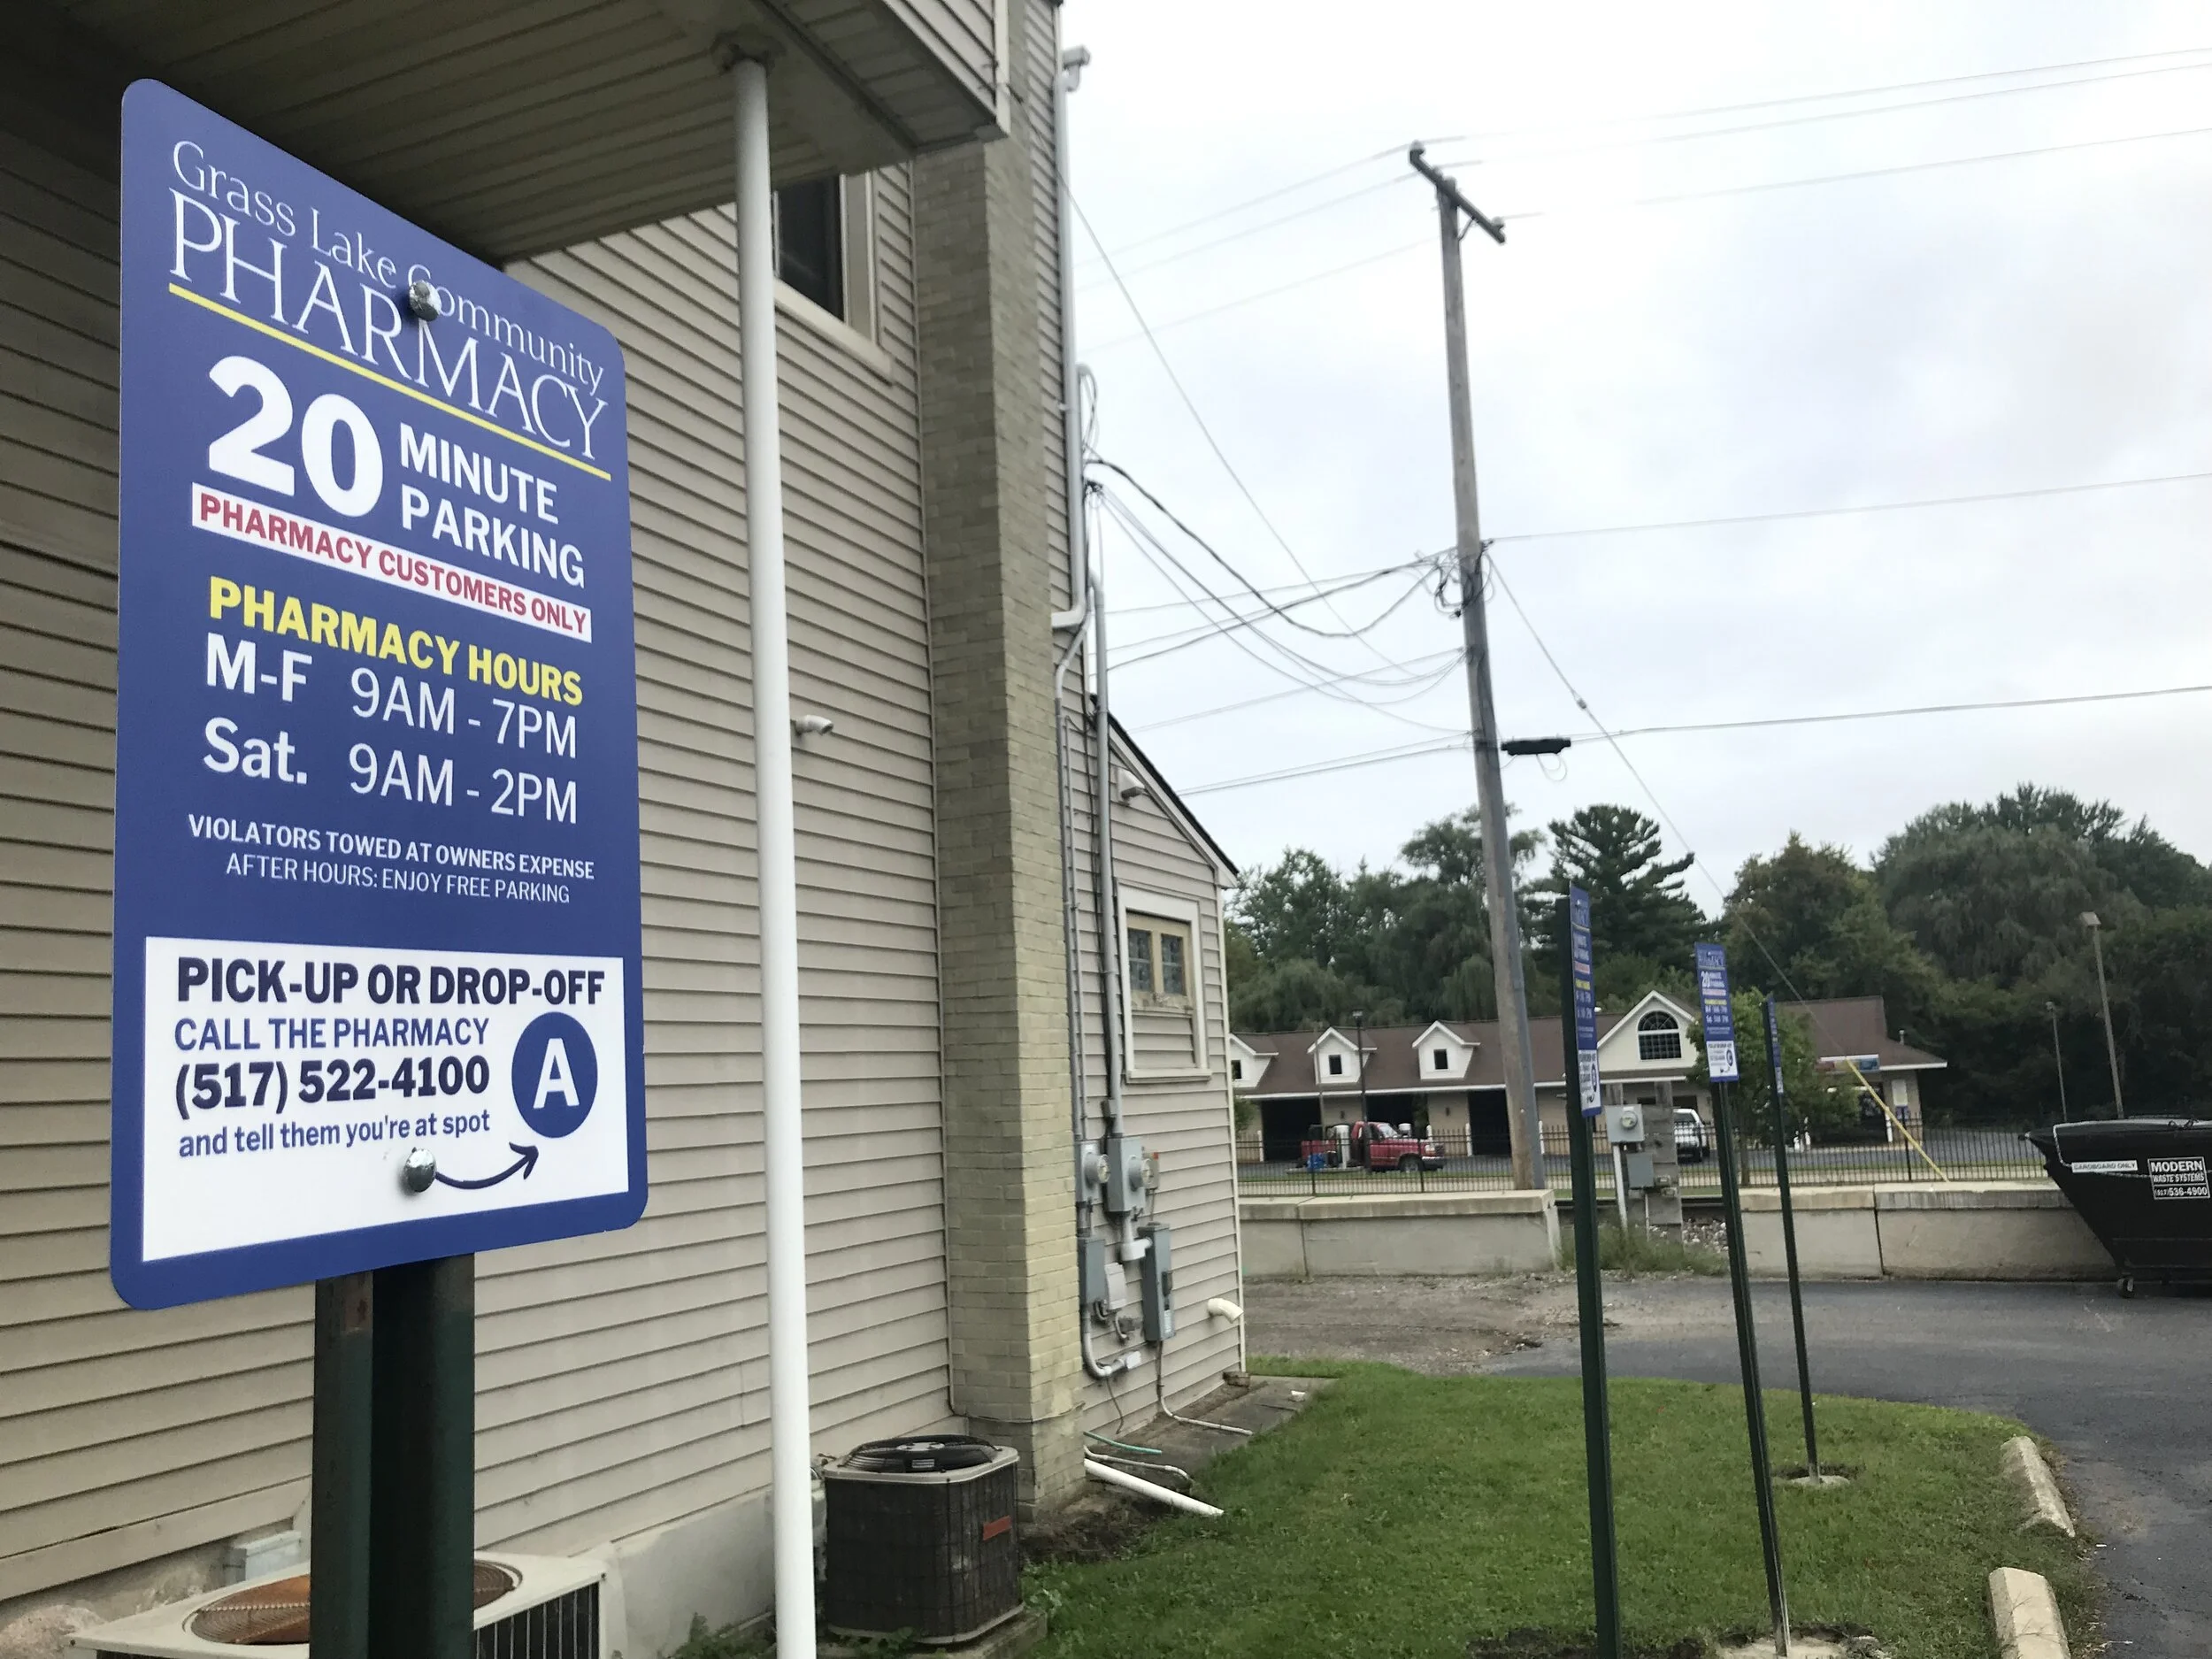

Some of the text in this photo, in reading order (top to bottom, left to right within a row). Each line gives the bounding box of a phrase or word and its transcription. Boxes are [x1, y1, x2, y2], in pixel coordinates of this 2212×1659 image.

[173, 141, 295, 236] Grass
[312, 208, 396, 288] Lake
[170, 188, 608, 460] PHARMACY
[209, 355, 383, 517] 20
[400, 422, 558, 524] MINUTE
[200, 493, 586, 634] PHARMACY CUSTOMERS ONLY
[402, 484, 584, 588] PARKING
[211, 576, 583, 705] PHARMACY HOURS
[206, 633, 312, 702] M-F
[350, 668, 454, 734] 9AM
[492, 698, 576, 758] 7PM
[204, 718, 307, 784] Sat.
[349, 743, 453, 806] 9AM
[490, 769, 577, 824] 2PM
[188, 814, 595, 879] VIOLATORS TOWED AT OWNERS EXPENSE
[227, 854, 569, 903] AFTER HOURS: ENJOY FREE PARKING
[178, 956, 604, 1005] PICK-UP OR DROP-OFF
[175, 1018, 488, 1051] CALL THE PHARMACY
[534, 1038, 579, 1109] A
[176, 1055, 489, 1119] (517) 522-4100
[179, 1110, 489, 1157] and tell them you're at spot
[2151, 1160, 2202, 1172] MODERN
[2152, 1171, 2204, 1183] WASTE SYSTEMS
